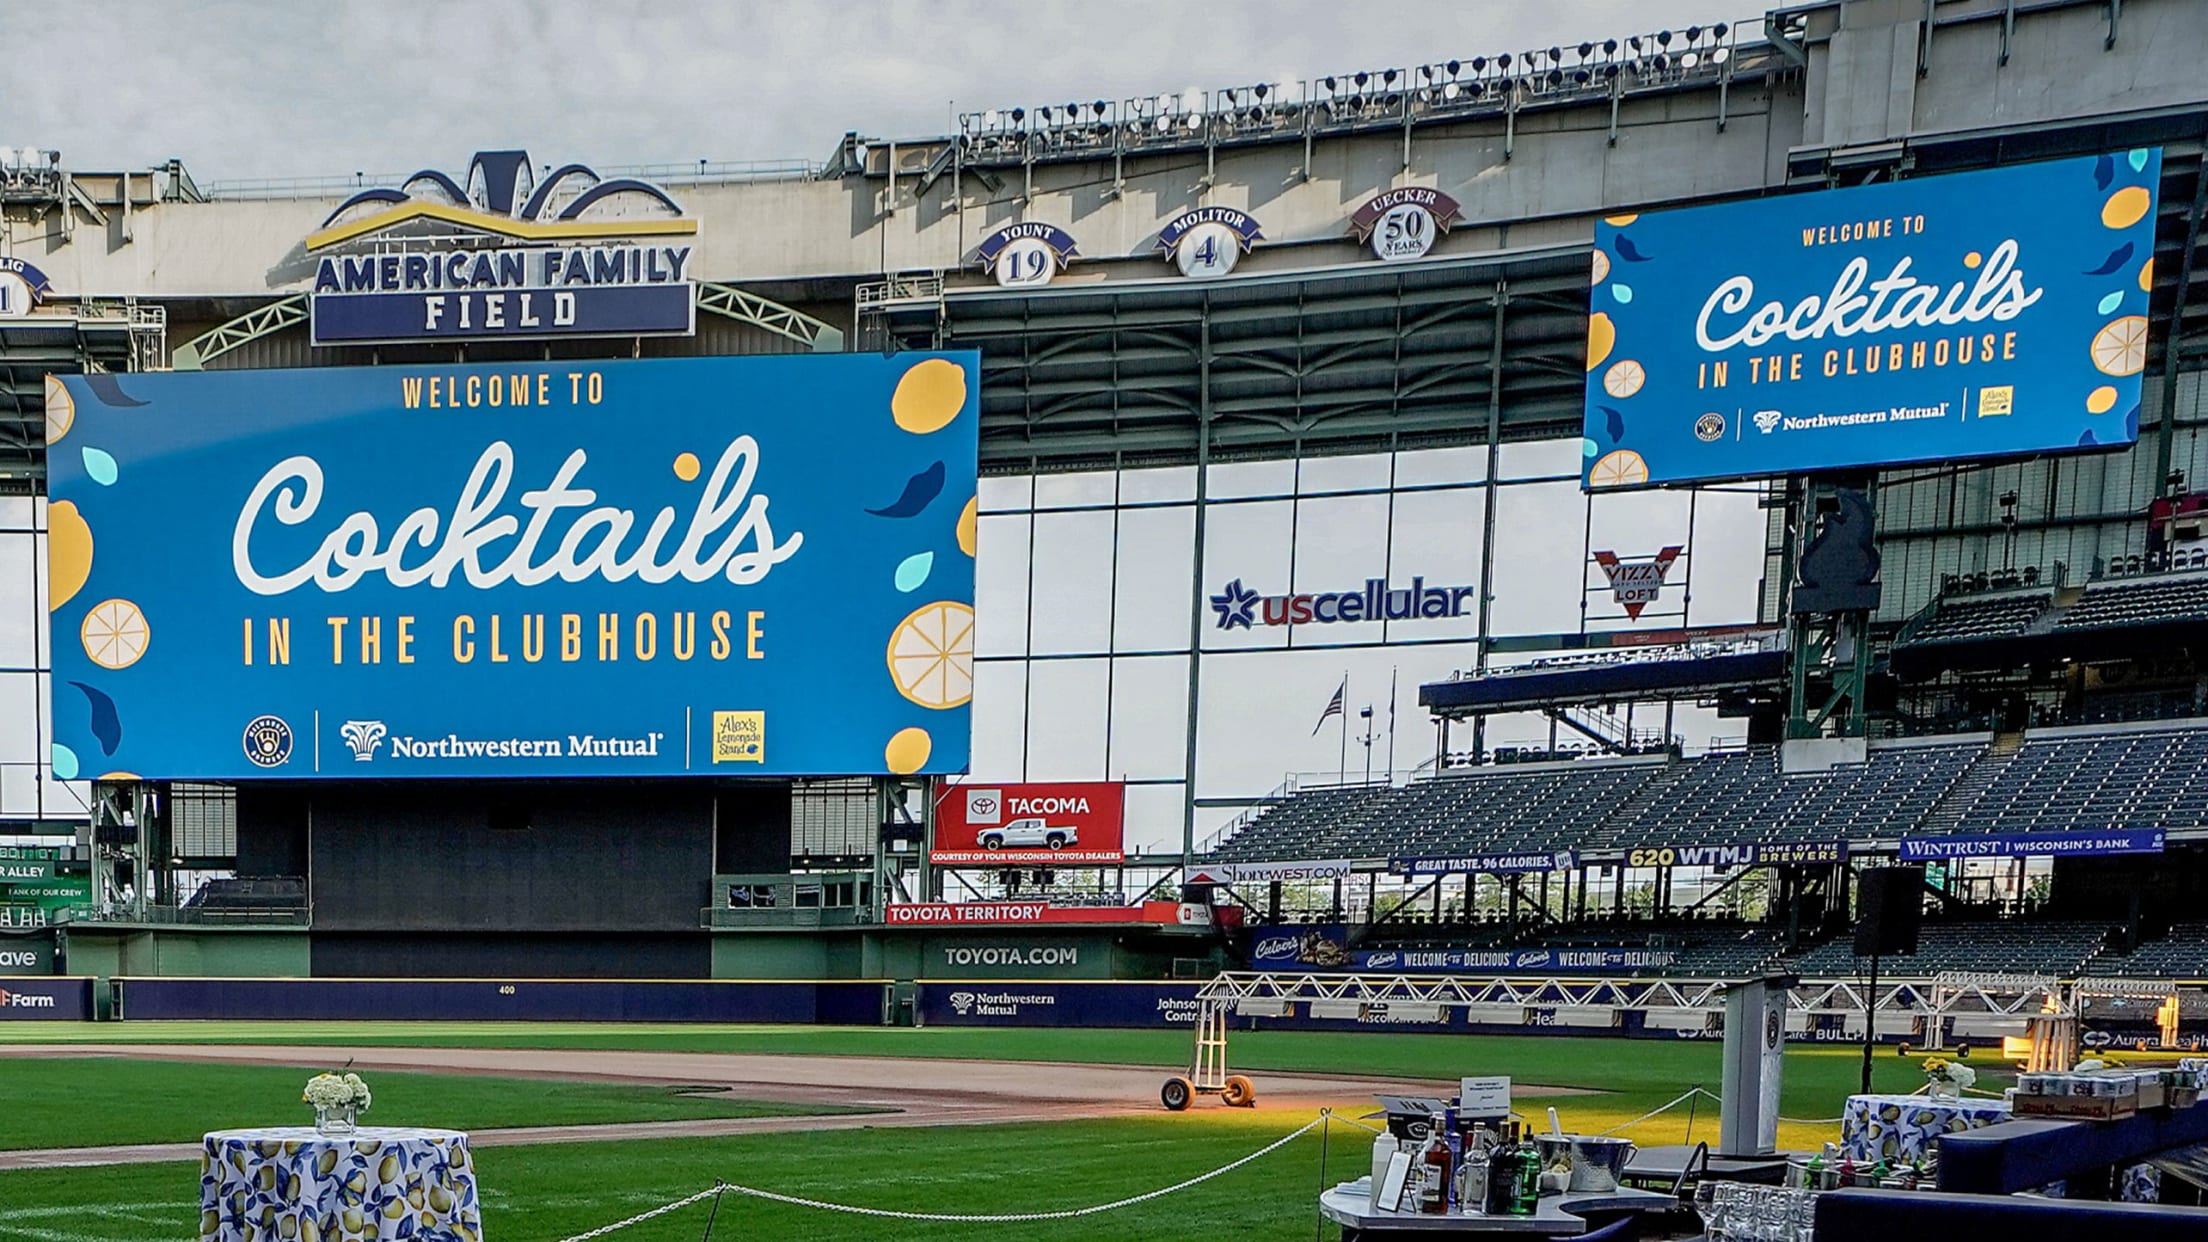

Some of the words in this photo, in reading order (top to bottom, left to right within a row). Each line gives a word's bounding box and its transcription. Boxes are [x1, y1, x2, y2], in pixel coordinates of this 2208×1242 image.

[1371, 188, 1437, 212] UECKER
[1173, 208, 1246, 234] MOLITOR
[1385, 211, 1425, 240] 50
[1001, 224, 1054, 242] YOUNT
[1802, 217, 1894, 247] WELCOME
[1903, 214, 1926, 235] TO
[1195, 235, 1217, 267] 4
[1386, 240, 1422, 251] YEARS
[315, 251, 527, 293] AMERICAN
[543, 246, 691, 285] FAMILY
[1006, 250, 1048, 282] 19
[1696, 239, 2043, 352] Cocktails
[424, 291, 578, 330] FIELD
[1698, 360, 1727, 389] IN
[1749, 353, 1803, 384] THE
[1823, 331, 2017, 378] CLUBHOUSE
[402, 373, 551, 410] WELCOME
[568, 371, 604, 405] TO
[1783, 410, 1886, 432] Northwestern
[233, 435, 803, 595] Cocktails
[1606, 564, 1670, 581] VIZZY
[1616, 589, 1657, 601] LOFT
[243, 617, 291, 666] IN
[327, 615, 415, 665] THE
[453, 610, 766, 664] CLUBHOUSE
[720, 715, 756, 733] Alex's
[391, 734, 563, 758] Northwestern
[717, 733, 760, 744] Lemonade
[719, 743, 745, 755] Stand
[1008, 797, 1090, 815] TACOMA
[1629, 849, 1675, 866] 620
[1679, 845, 1753, 865] WTMJ
[1759, 850, 1839, 862] BREWERS
[1906, 840, 2001, 856] WINTRUST
[2014, 839, 2093, 851] WISCONSIN'S
[2096, 838, 2130, 849] BANK
[931, 853, 972, 861] COURTESY
[972, 853, 984, 861] OF
[985, 853, 1006, 861] YOUR
[1085, 852, 1121, 860] DEALERS
[1415, 860, 1447, 871] GREAT
[1448, 858, 1481, 870] TASTE.
[1483, 858, 1497, 869] 96
[1498, 856, 1552, 868] CALORIES.
[8, 867, 44, 877] ALLEY
[891, 907, 951, 921] TOYOTA
[955, 905, 1043, 921] TERRITORY
[1255, 936, 1298, 958] Culver's
[945, 948, 1077, 965] TOYOTA.COM
[1404, 952, 1448, 967] WELCOME
[1464, 952, 1510, 967] DELICIOUS
[1559, 952, 1607, 966] WELCOME
[1624, 952, 1674, 966] DELICIOUS
[499, 985, 515, 994] 400
[976, 992, 1055, 1005] Northwestern
[12, 994, 55, 1007] Farm
[976, 1004, 1017, 1016] Mutual
